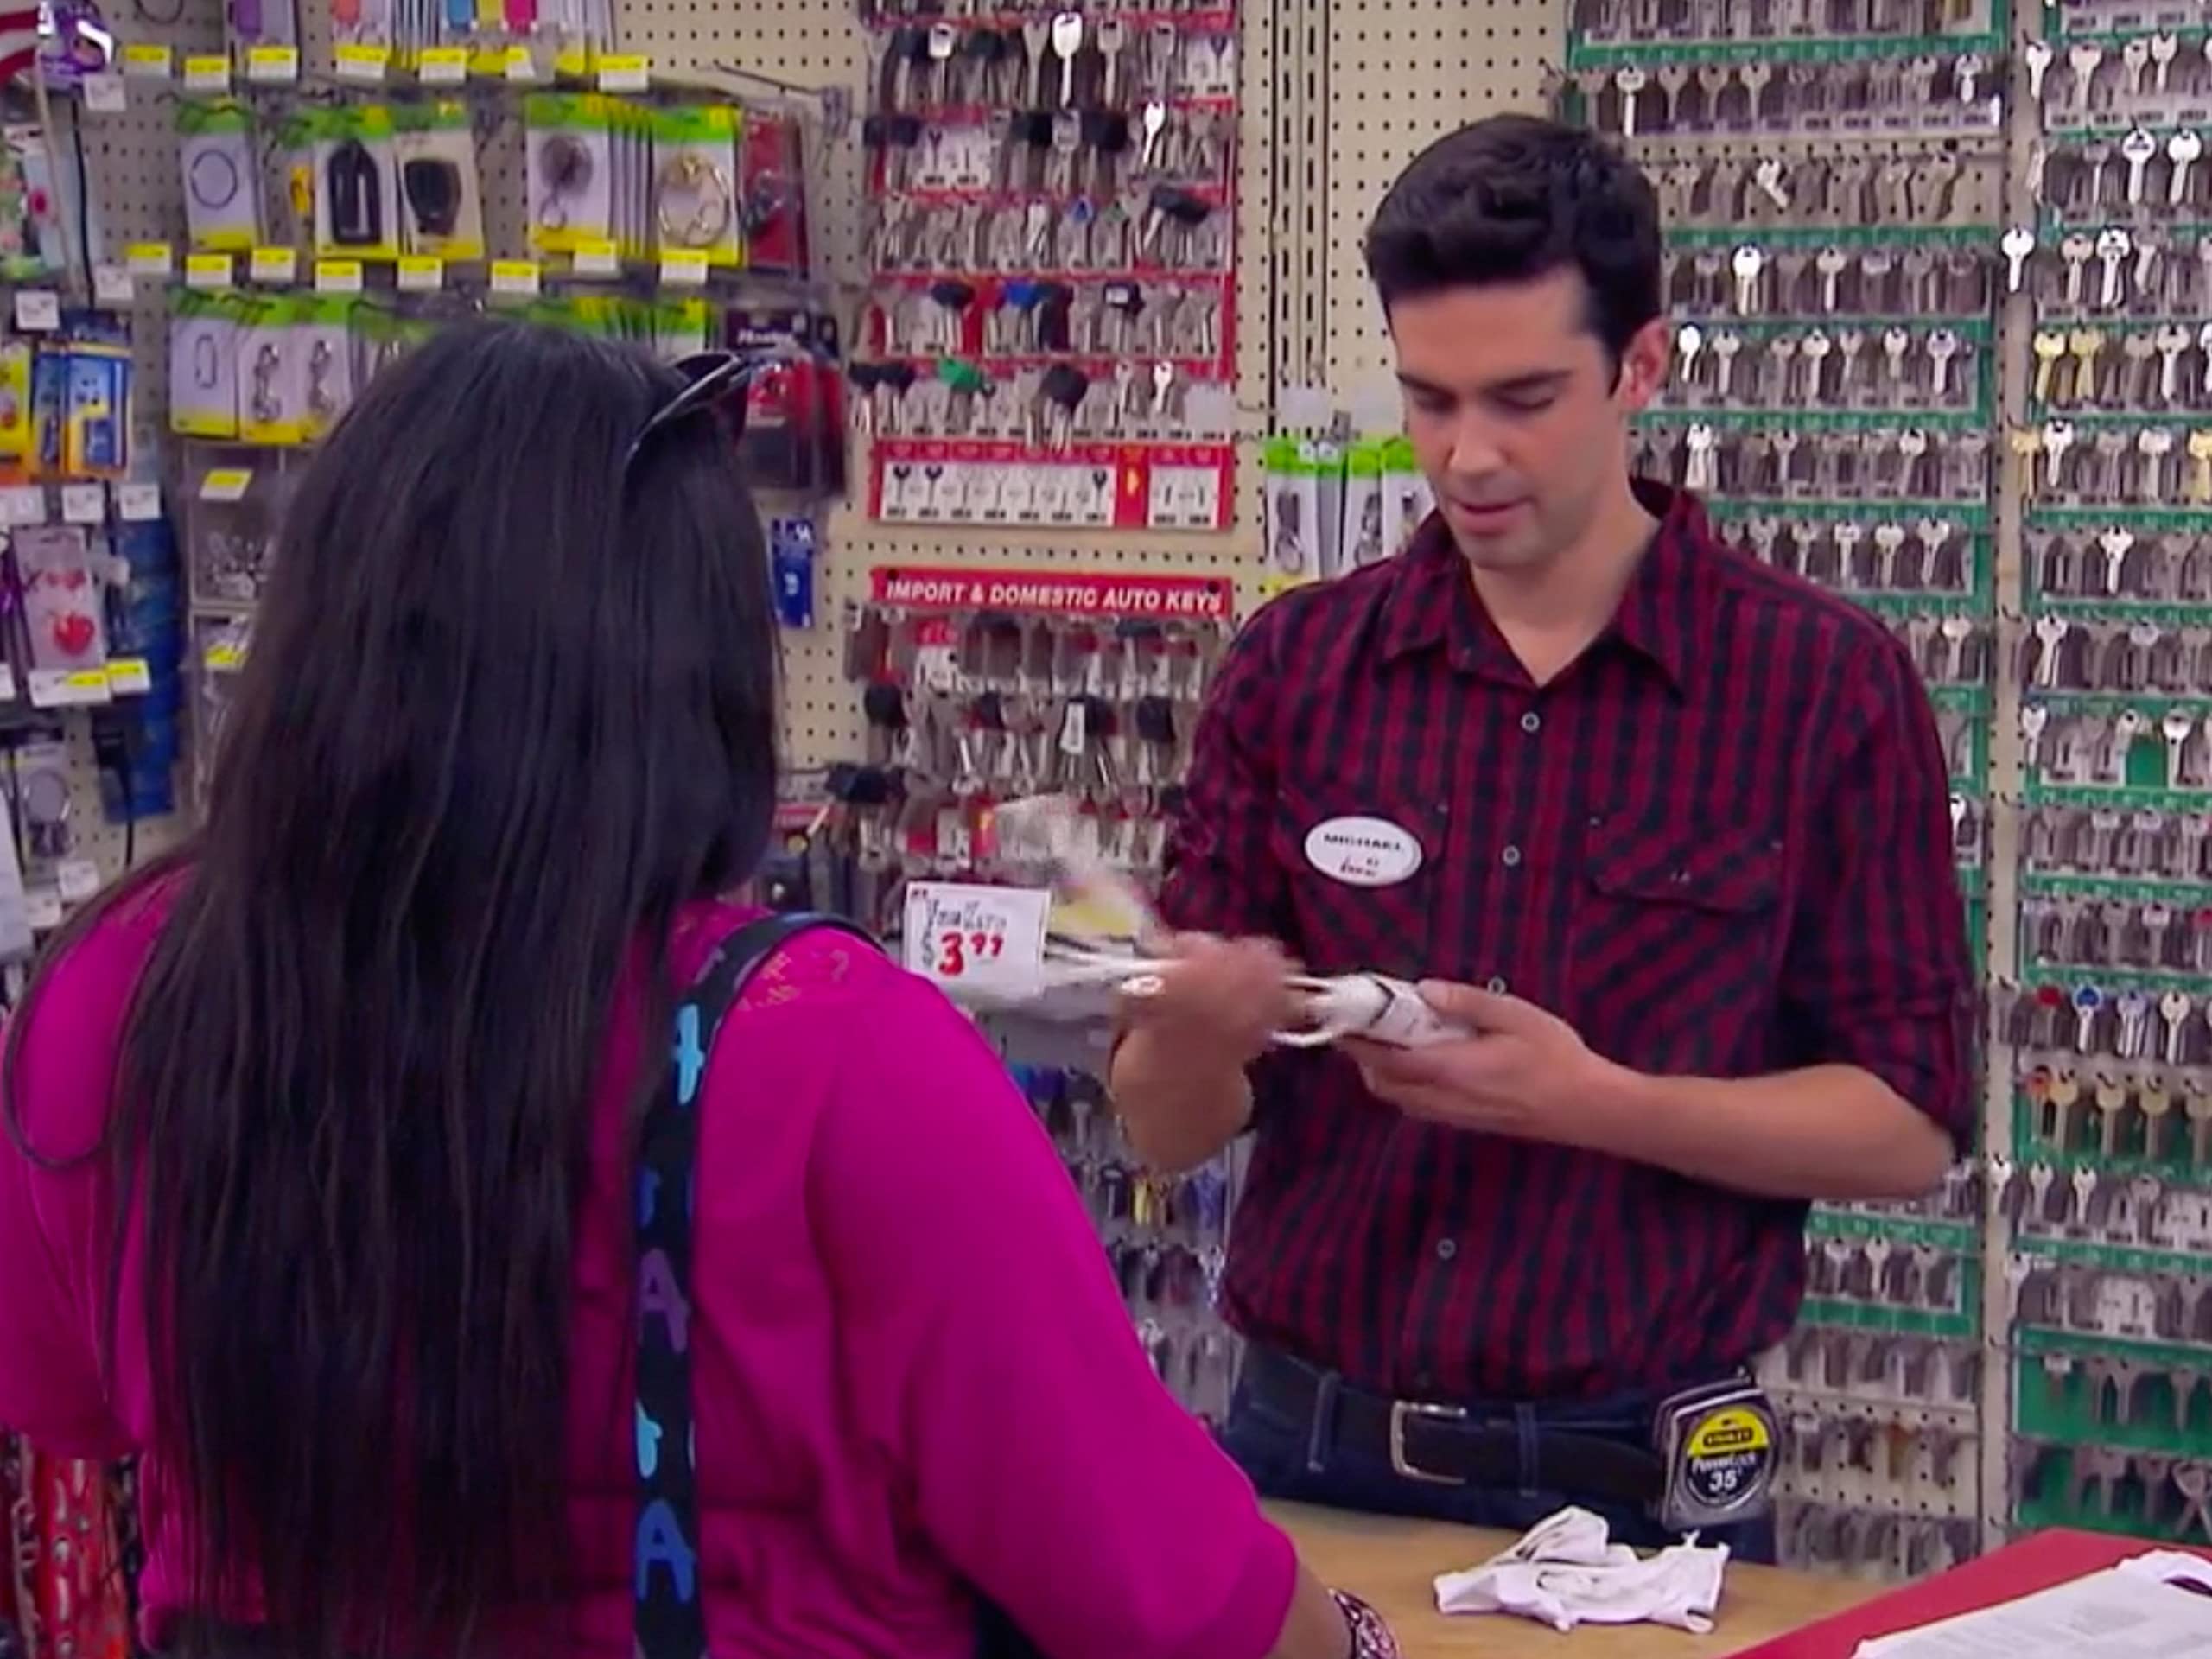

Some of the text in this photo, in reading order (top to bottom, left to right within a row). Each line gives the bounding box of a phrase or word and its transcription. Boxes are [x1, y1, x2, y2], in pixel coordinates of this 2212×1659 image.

[886, 579, 1222, 613] IMPORT & DOMESTIC AUTO KEYS
